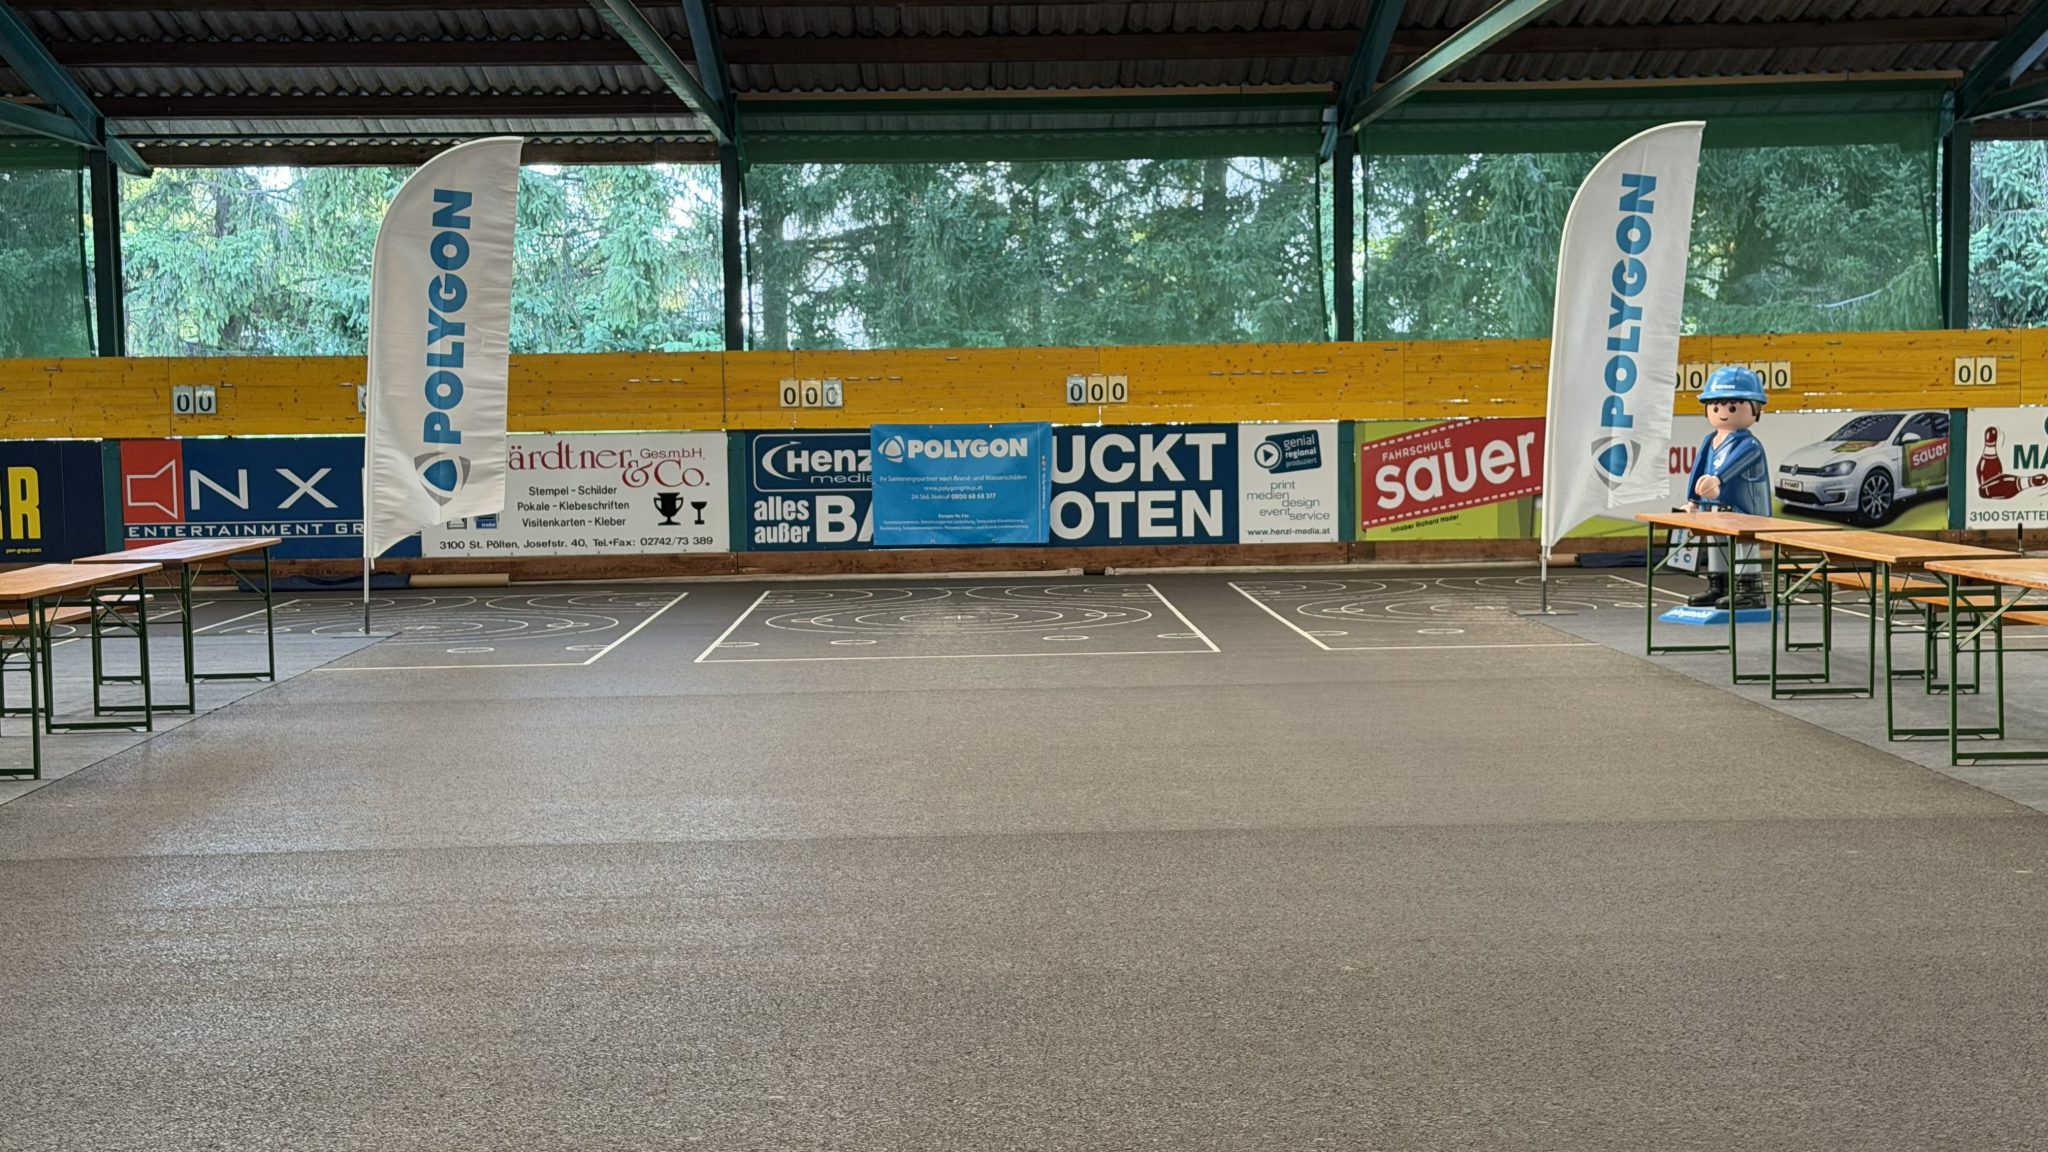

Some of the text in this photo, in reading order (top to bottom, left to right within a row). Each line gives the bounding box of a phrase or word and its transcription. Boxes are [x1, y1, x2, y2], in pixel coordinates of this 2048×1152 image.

[1601, 173, 1657, 429] POLYGON
[423, 188, 473, 445] POLYGON
[908, 437, 1028, 459] POLYGON
[1283, 434, 1316, 451] genial
[1382, 438, 1451, 462] FAHRSCHULE
[508, 440, 632, 471] ärdtner
[1051, 433, 1226, 484] UCKT
[1285, 447, 1317, 459] regional
[1912, 442, 1948, 467] sauer
[1375, 431, 1535, 509] sauer
[528, 487, 569, 497] Stempel
[577, 485, 617, 495] Schilder
[1246, 490, 1289, 500] medien
[1271, 481, 1295, 494] print
[0, 466, 41, 540] R
[517, 502, 550, 511] Pokale
[559, 500, 630, 510] Klebeschriften
[754, 496, 810, 520] alles
[1282, 498, 1320, 509] design
[1050, 489, 1223, 540] OTEN
[1259, 507, 1290, 517] event
[1289, 511, 1330, 521] service
[1969, 510, 2048, 522] 3100 STATTE
[522, 517, 586, 527] Visitenkarten
[594, 516, 626, 526] Kleber
[128, 523, 323, 538] ENTERTAINMENT
[754, 522, 810, 543] außer
[439, 540, 465, 550] 3100
[469, 540, 483, 549] St.
[486, 538, 520, 550] Pölten,
[523, 538, 568, 549] Josefstr.
[571, 538, 588, 549] 40,
[640, 536, 689, 547] 02742/73
[693, 536, 713, 546] 389
